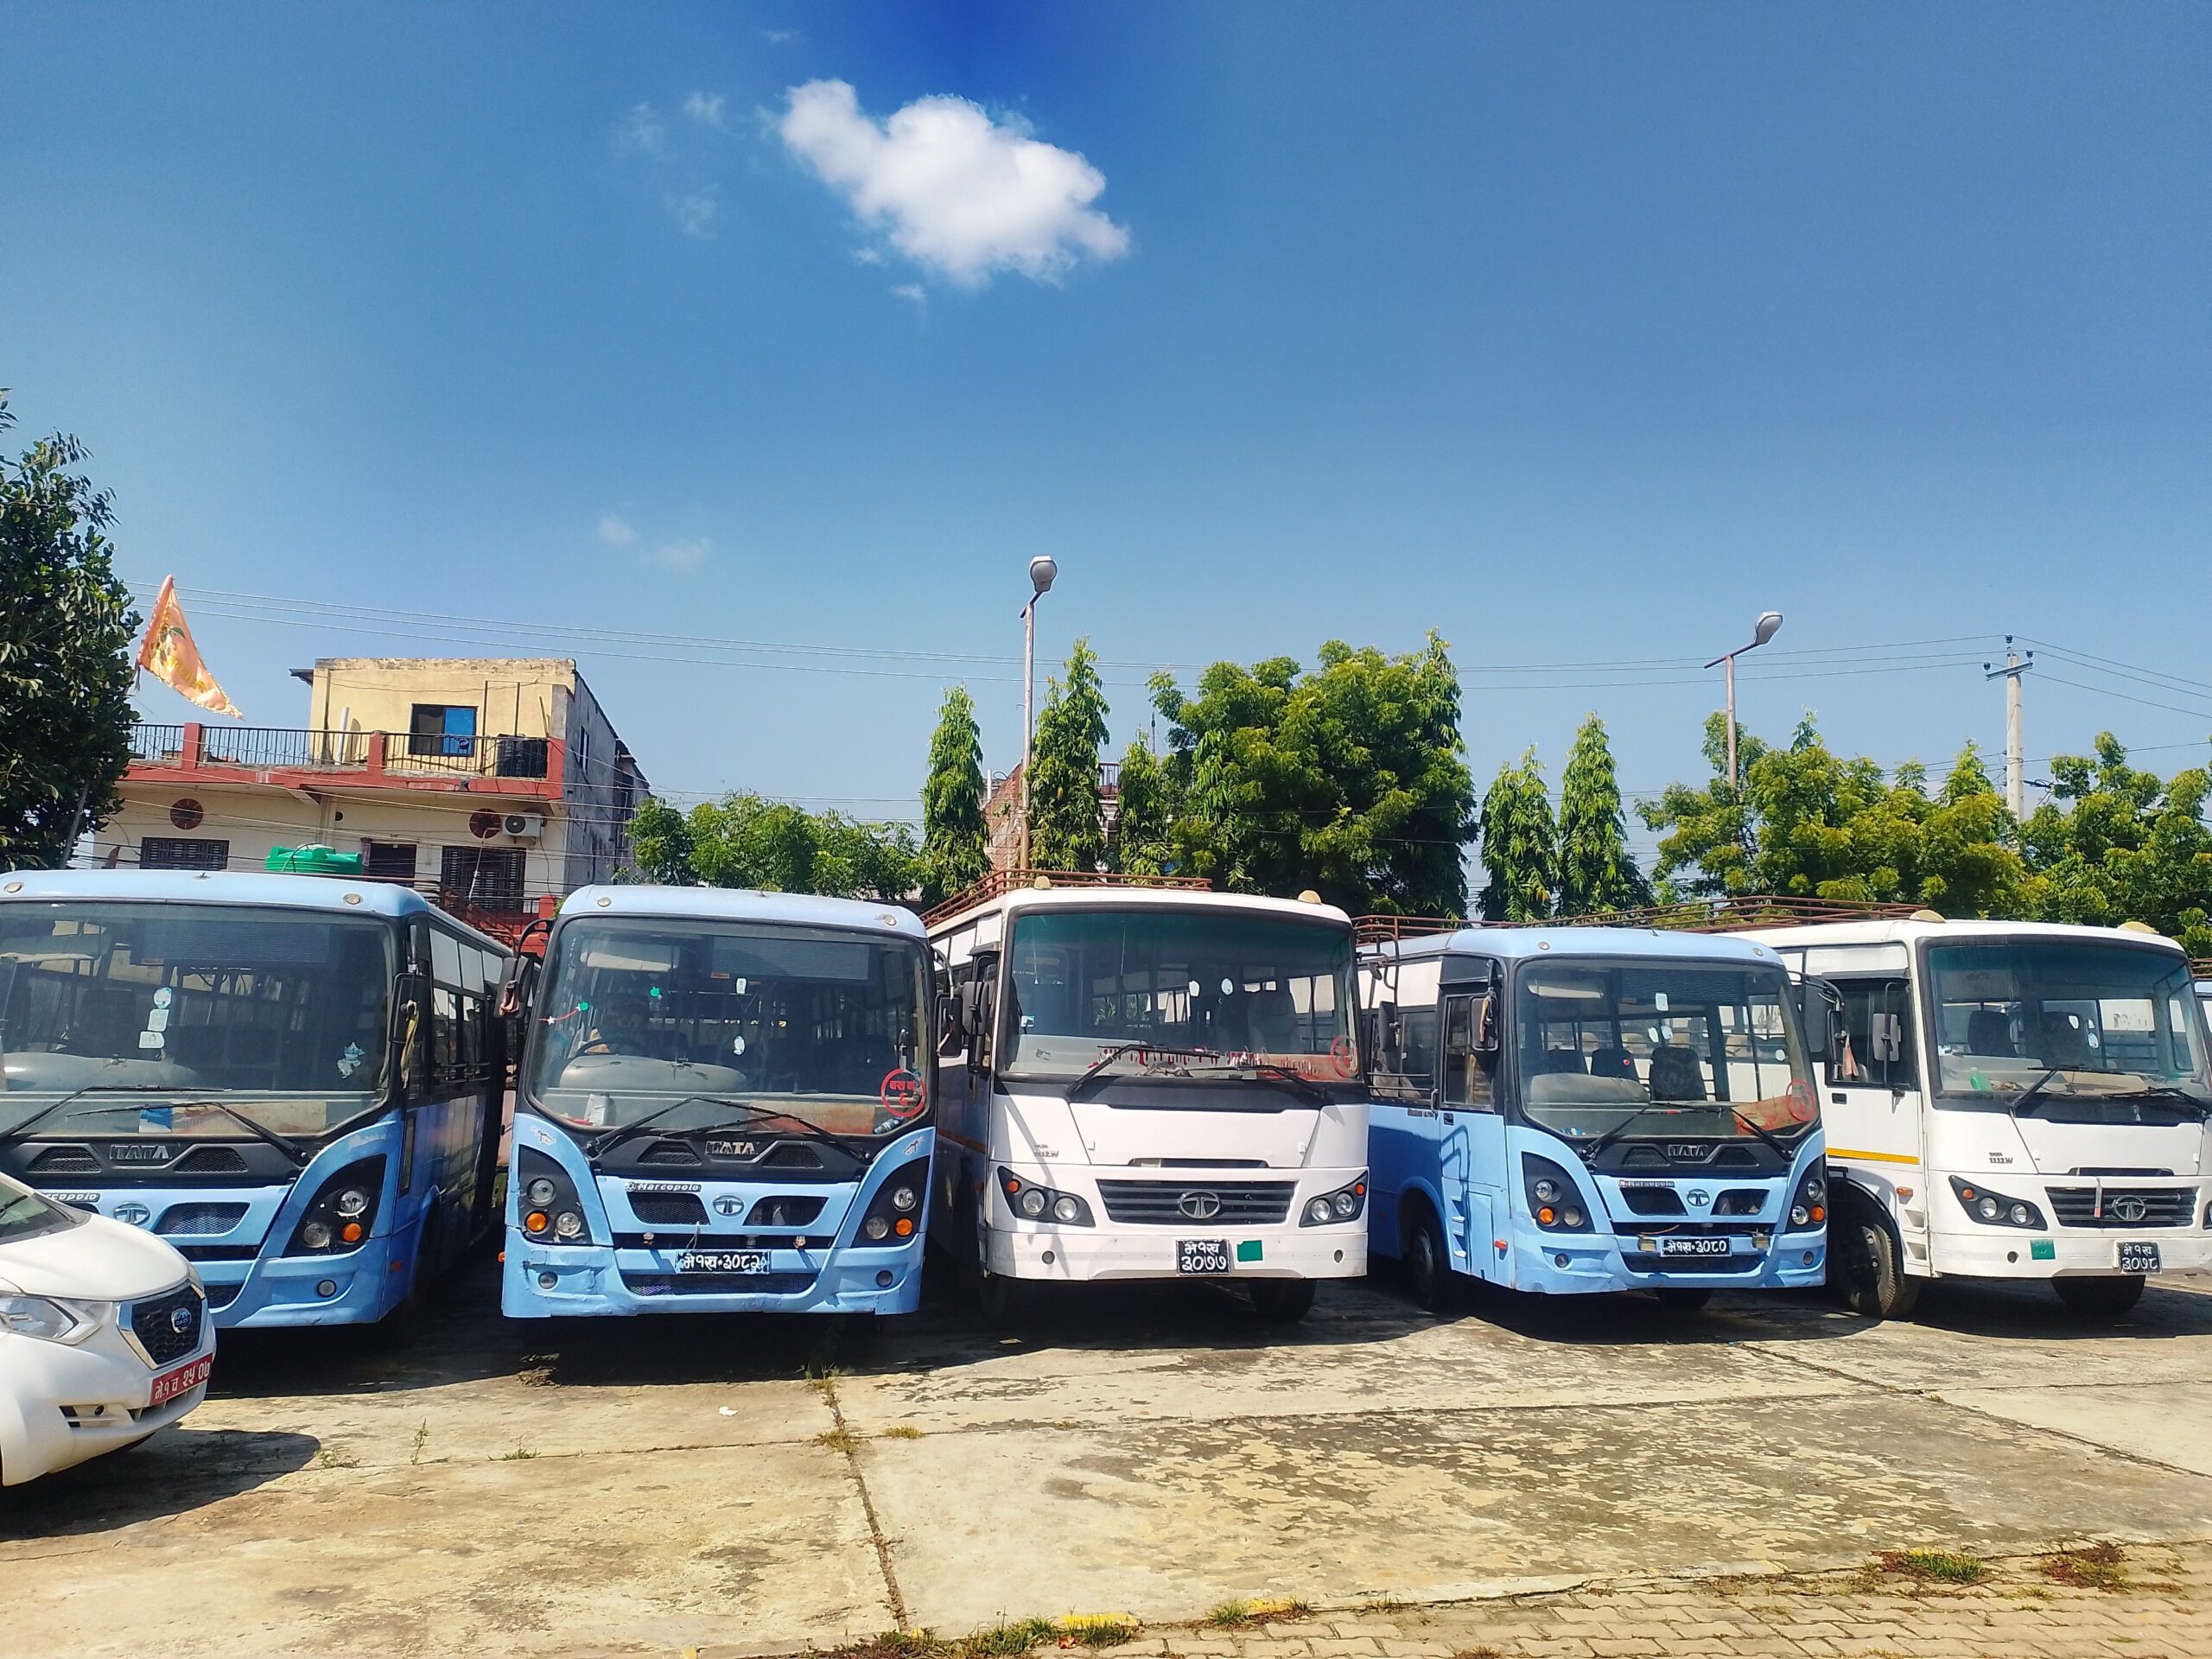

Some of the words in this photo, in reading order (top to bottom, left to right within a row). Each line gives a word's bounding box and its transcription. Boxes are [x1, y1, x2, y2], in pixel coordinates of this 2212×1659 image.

[114, 1145, 169, 1160] TATA
[711, 1141, 755, 1155] TATA
[1671, 1144, 1705, 1157] TATA
[636, 1182, 699, 1192] Marcopolo
[1180, 1255, 1227, 1272] ३०७७
[2121, 1256, 2158, 1271] ३०७८
